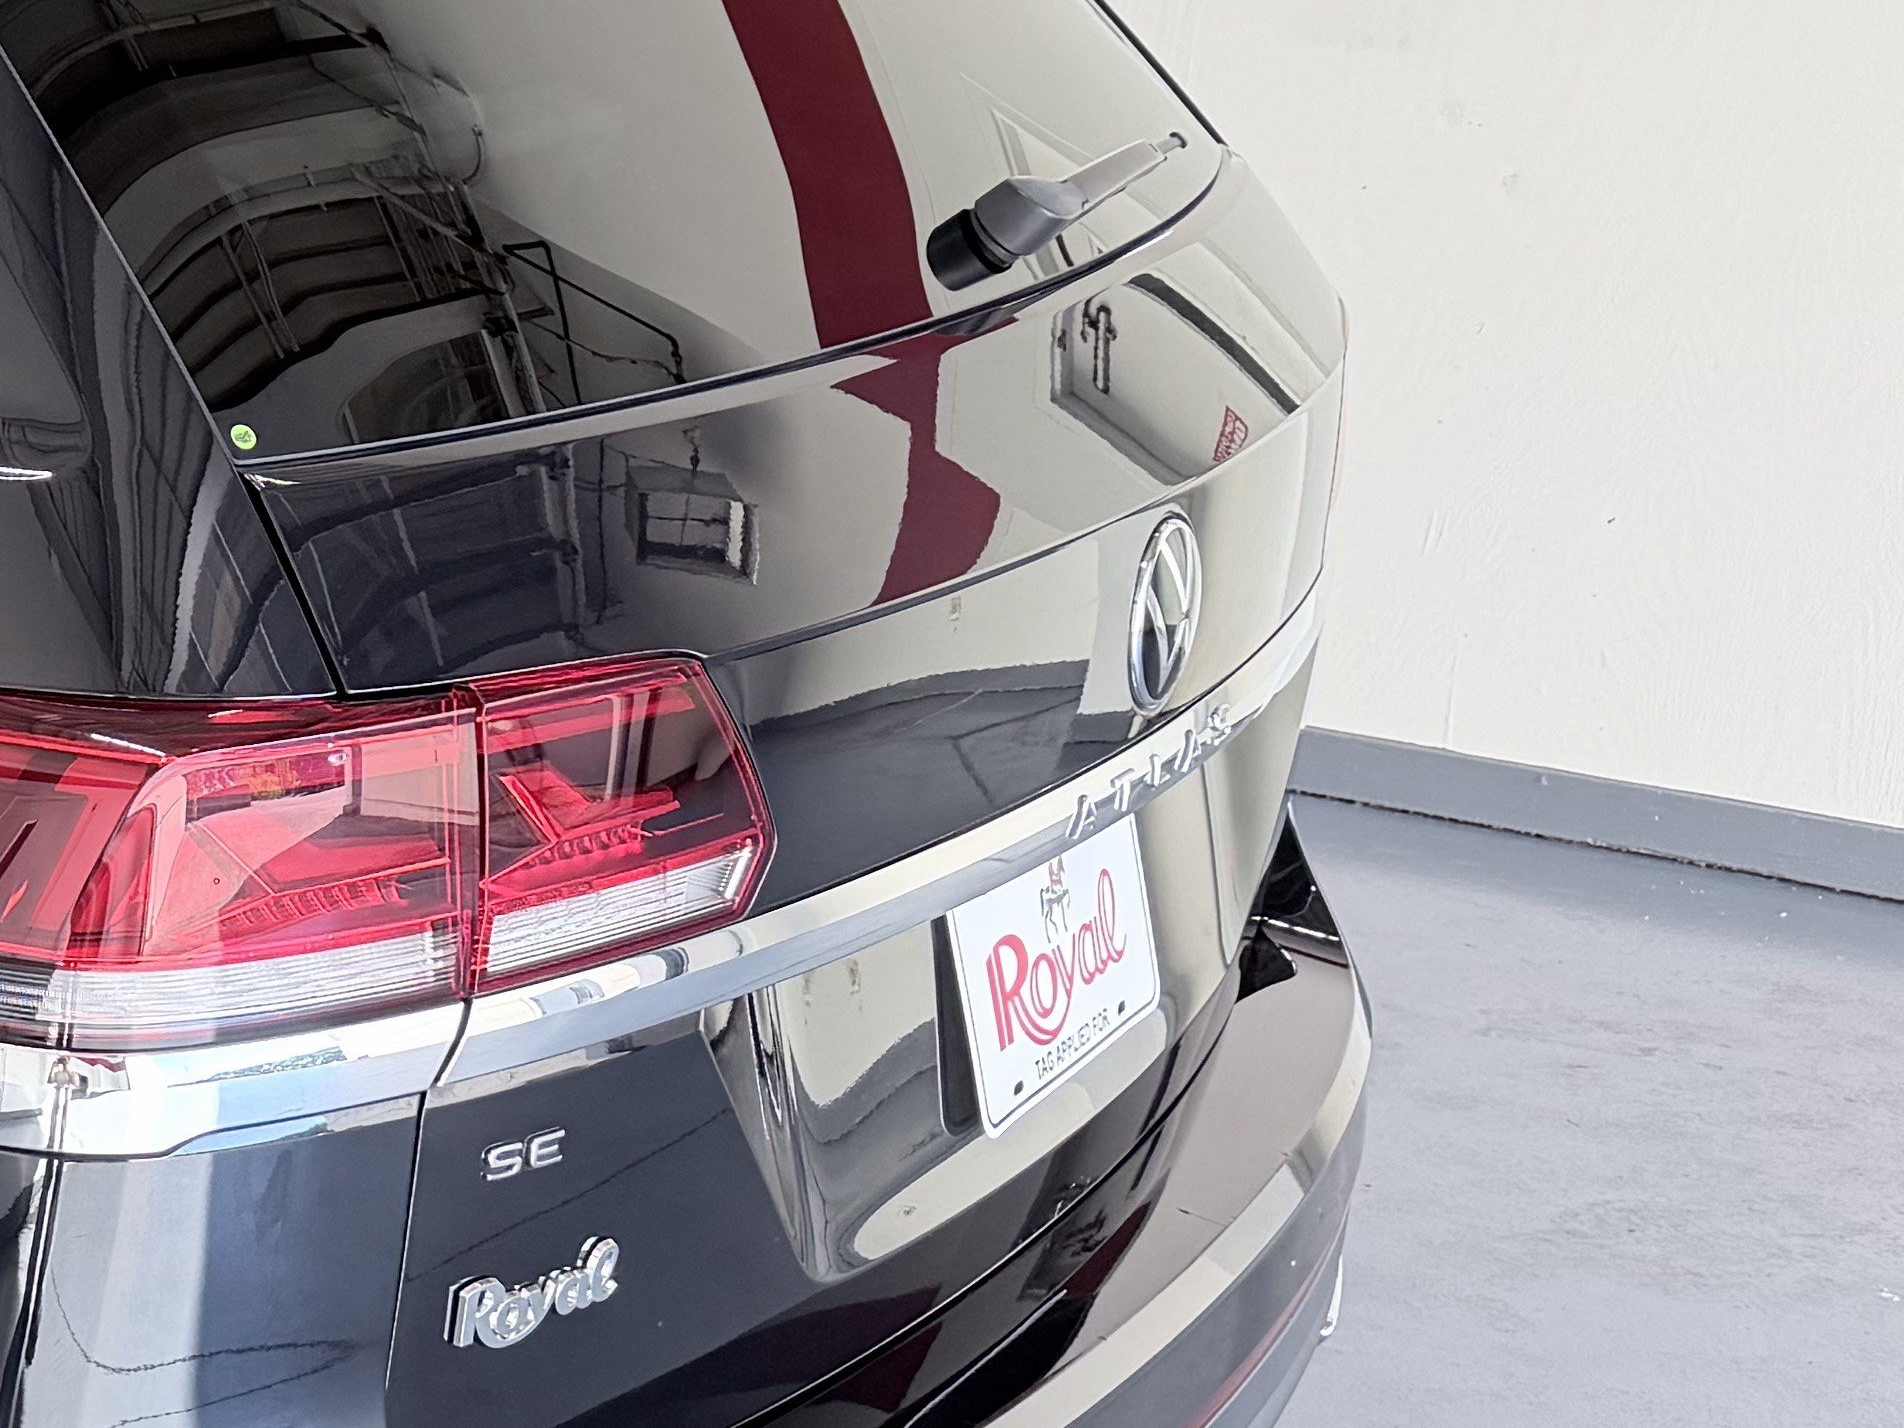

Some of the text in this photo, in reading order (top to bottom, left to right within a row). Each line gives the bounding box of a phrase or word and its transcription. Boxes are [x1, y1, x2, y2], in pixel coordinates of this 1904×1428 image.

[1065, 702, 1232, 841] ATLAS
[986, 868, 1128, 1052] Royal
[1034, 1007, 1112, 1081] TAG APPLIED FOR
[480, 1126, 566, 1182] SE
[443, 1235, 620, 1349] Royal
